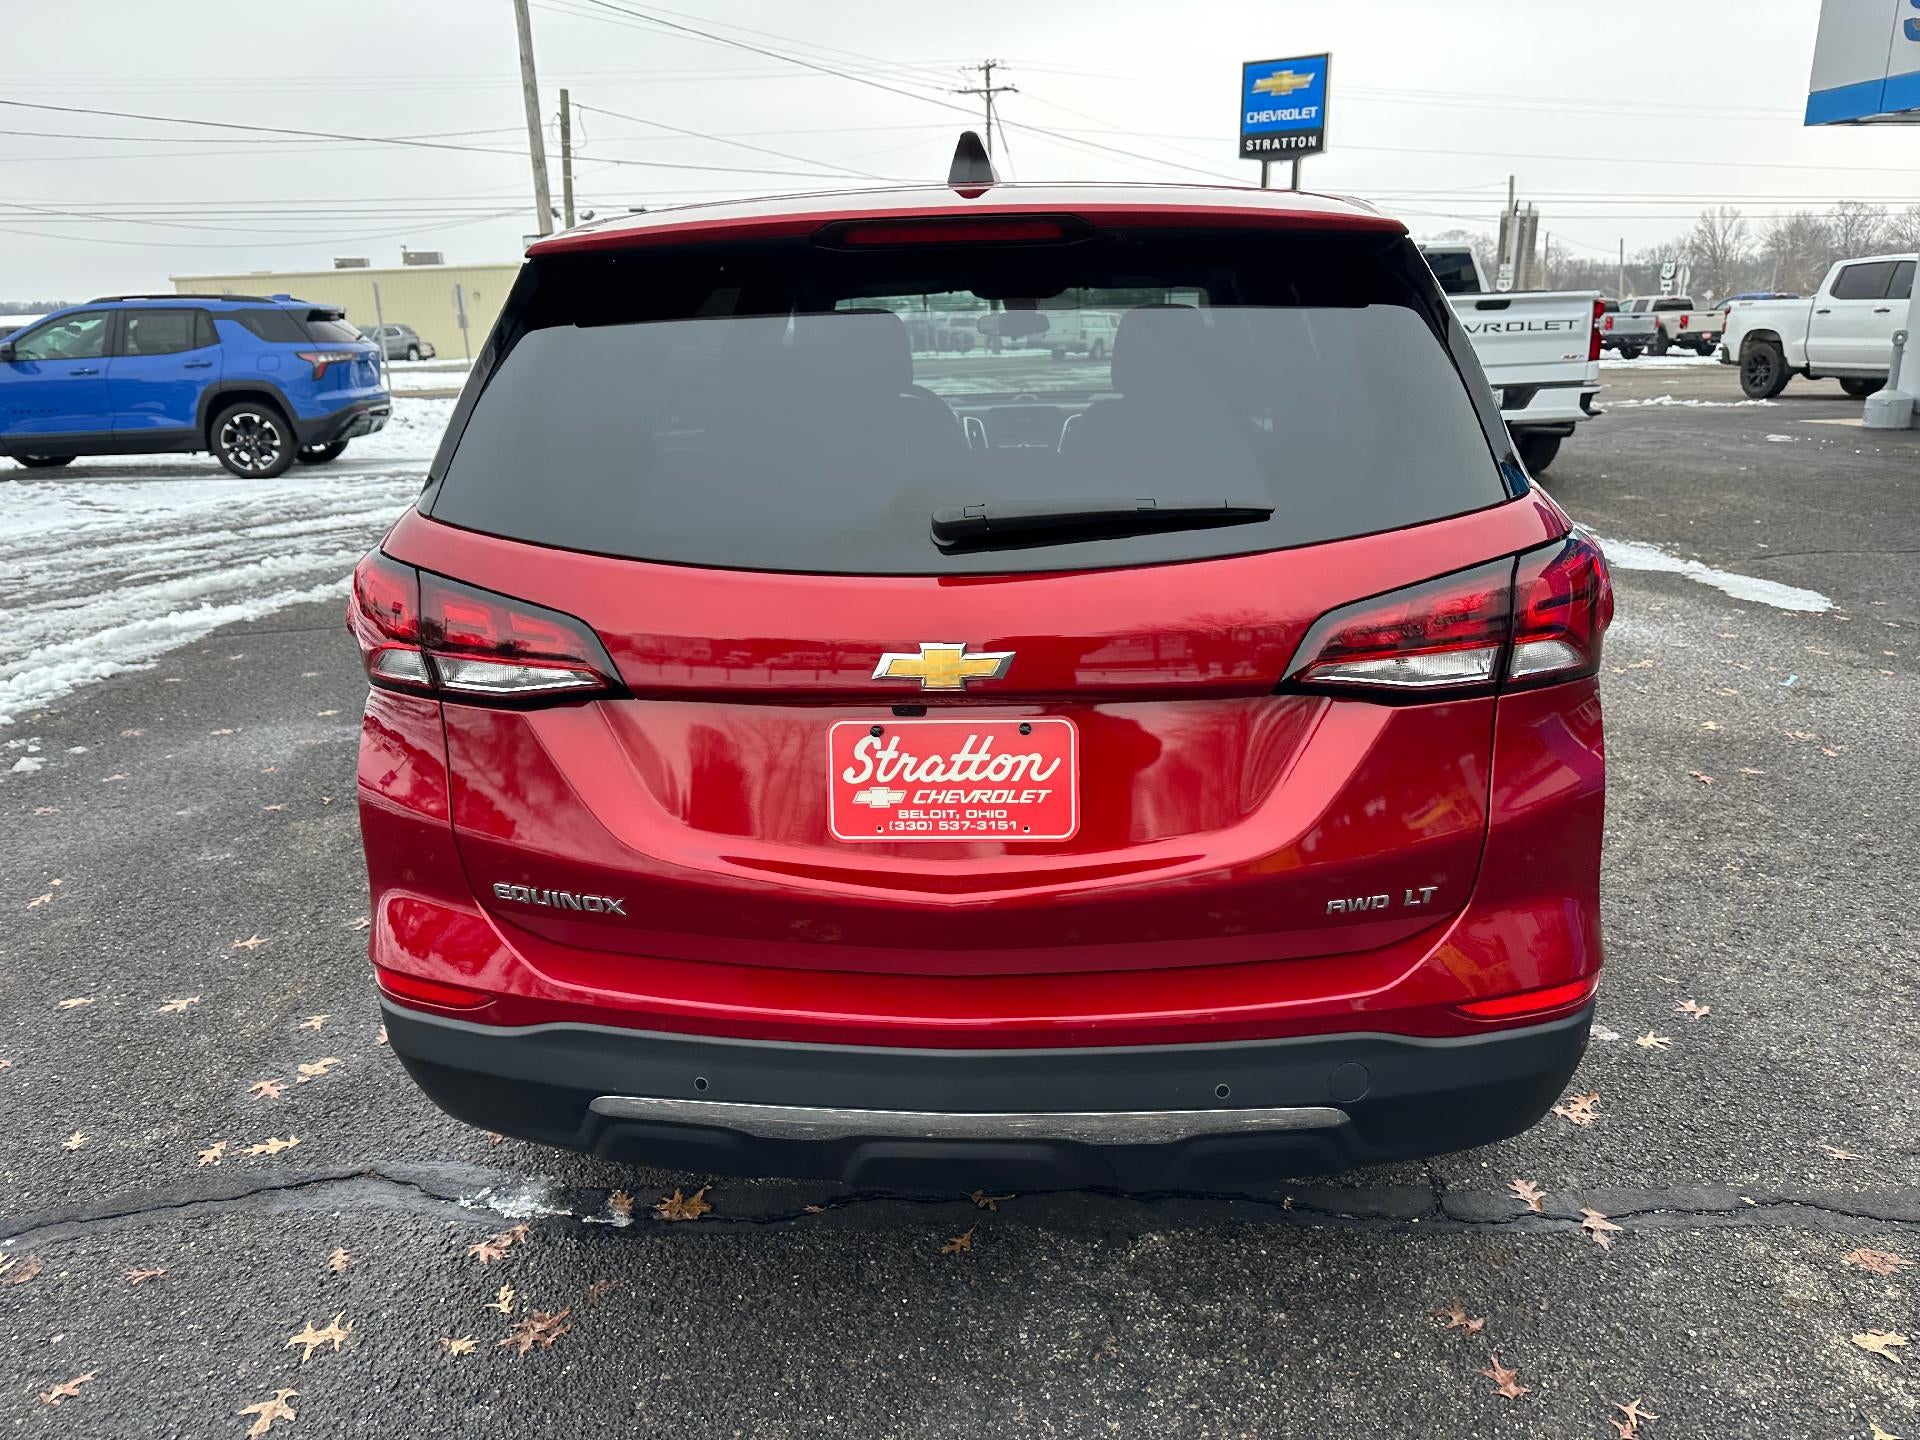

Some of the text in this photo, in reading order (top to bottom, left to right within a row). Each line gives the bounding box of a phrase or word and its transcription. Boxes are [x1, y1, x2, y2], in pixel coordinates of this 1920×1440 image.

[1246, 106, 1319, 124] CHEVROLET
[1245, 135, 1317, 151] STRATTON
[842, 734, 1061, 784] Stratton
[912, 789, 1052, 804] CHEVROLET
[898, 809, 1008, 820] BELOIT, OHIO
[889, 820, 1017, 831] (330) 537-3151
[493, 882, 627, 916] EQUINOX
[1326, 886, 1439, 915] AWD LT
